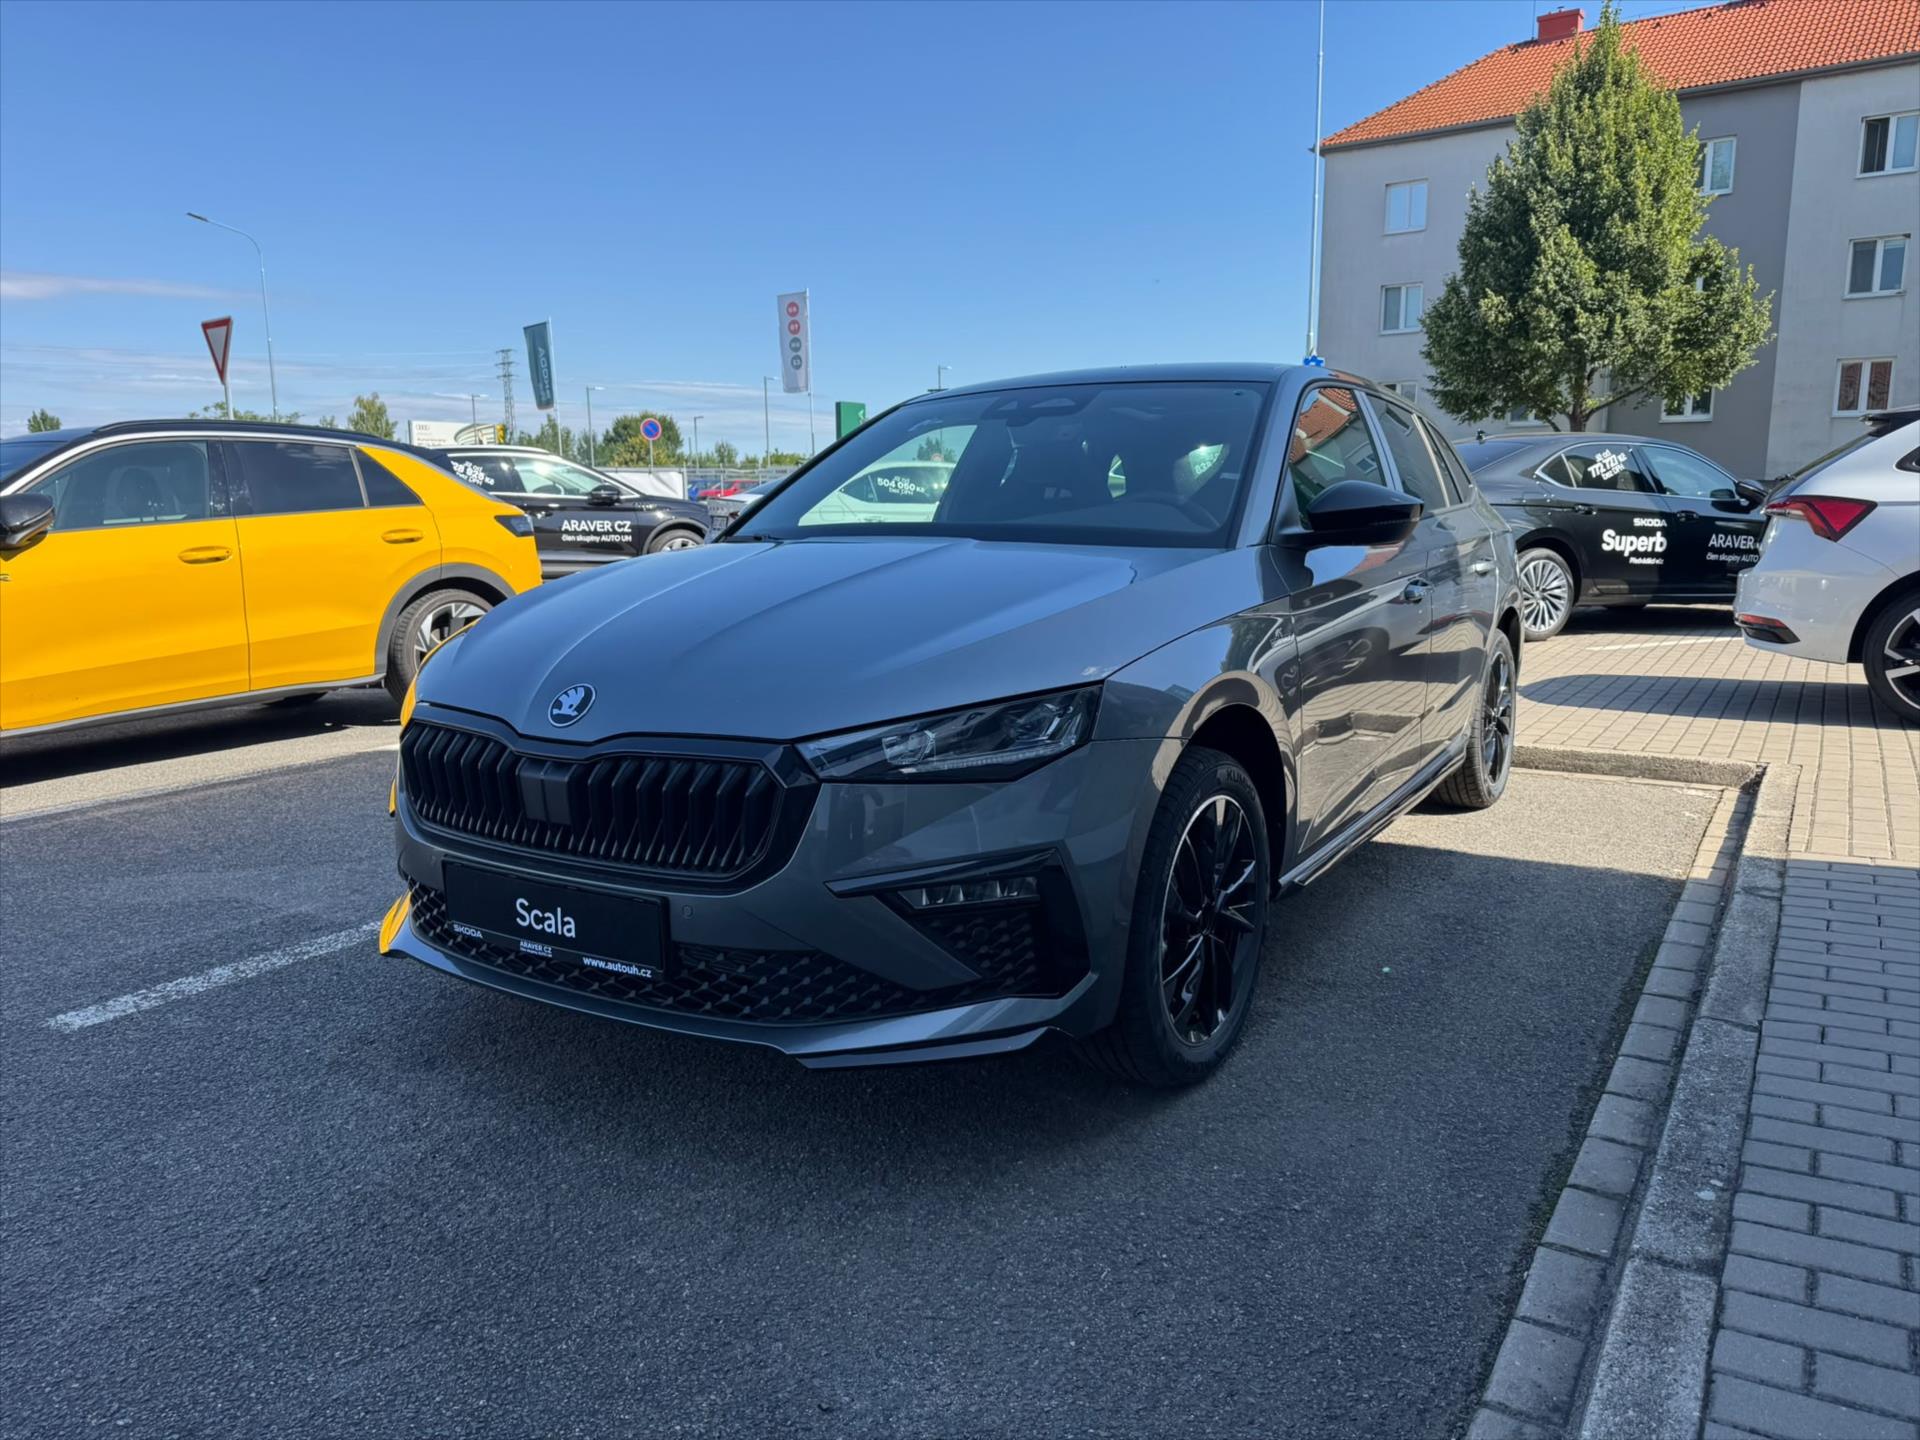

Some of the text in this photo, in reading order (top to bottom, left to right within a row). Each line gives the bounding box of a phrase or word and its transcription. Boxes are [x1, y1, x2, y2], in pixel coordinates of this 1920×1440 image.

[1602, 449, 1611, 458] od
[877, 477, 896, 488] 504
[561, 520, 632, 532] ARAVER CZ
[576, 534, 601, 543] skupiny
[1601, 529, 1667, 557] Superb
[1708, 534, 1755, 549] ARAVER
[1720, 553, 1740, 564] skupiny
[1741, 554, 1759, 563] AUTO
[516, 897, 576, 938] Scala
[520, 940, 542, 951] ARAVER
[543, 946, 552, 954] CZ
[582, 956, 652, 978] www.autouh.cz
